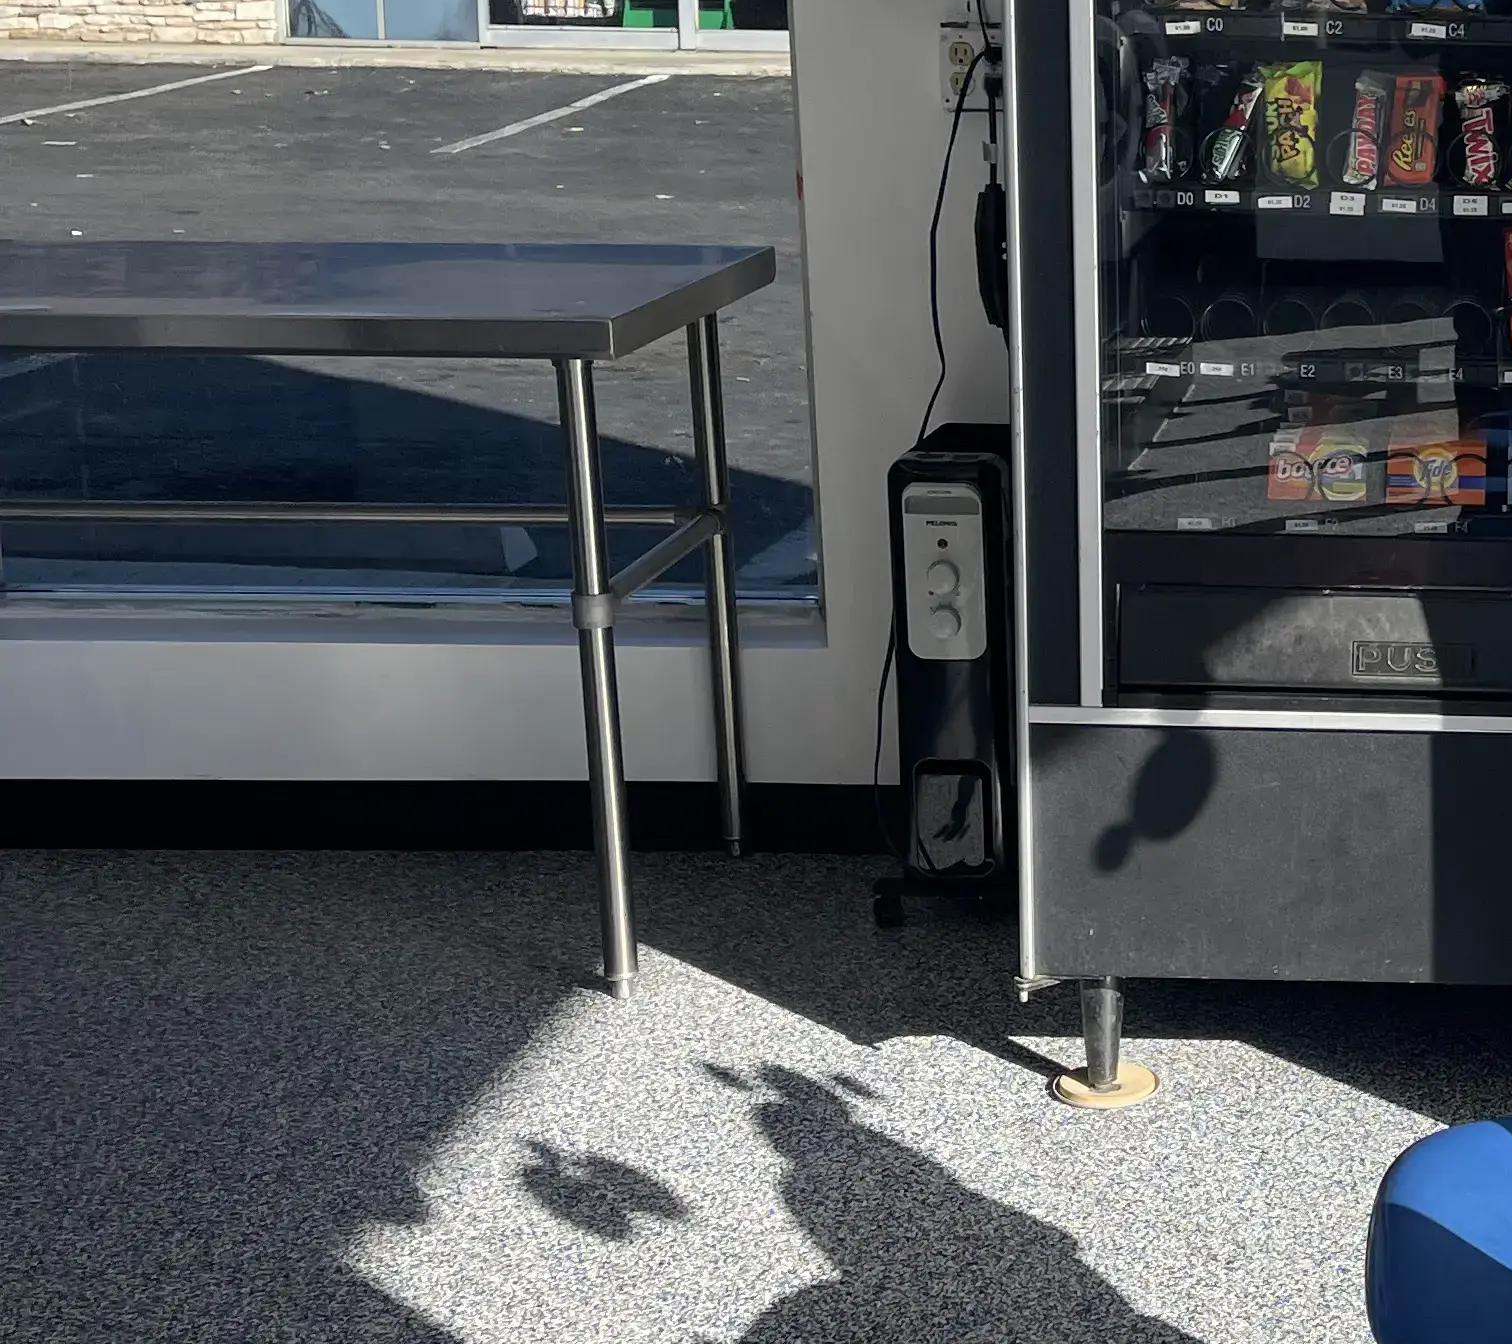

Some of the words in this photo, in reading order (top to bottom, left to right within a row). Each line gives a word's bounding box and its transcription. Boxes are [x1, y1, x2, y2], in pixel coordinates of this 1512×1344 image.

[1206, 17, 1224, 32] C0
[1325, 20, 1343, 35] C2
[1448, 23, 1465, 37] C4
[1391, 109, 1417, 171] Reee's
[1462, 106, 1496, 185] TWIX
[1177, 191, 1194, 206] D0
[1294, 194, 1311, 208] D2
[1420, 197, 1436, 211] D4
[1180, 362, 1195, 376] E0
[1241, 363, 1255, 377] E1
[1300, 364, 1316, 378] E2
[1388, 366, 1403, 380] E3
